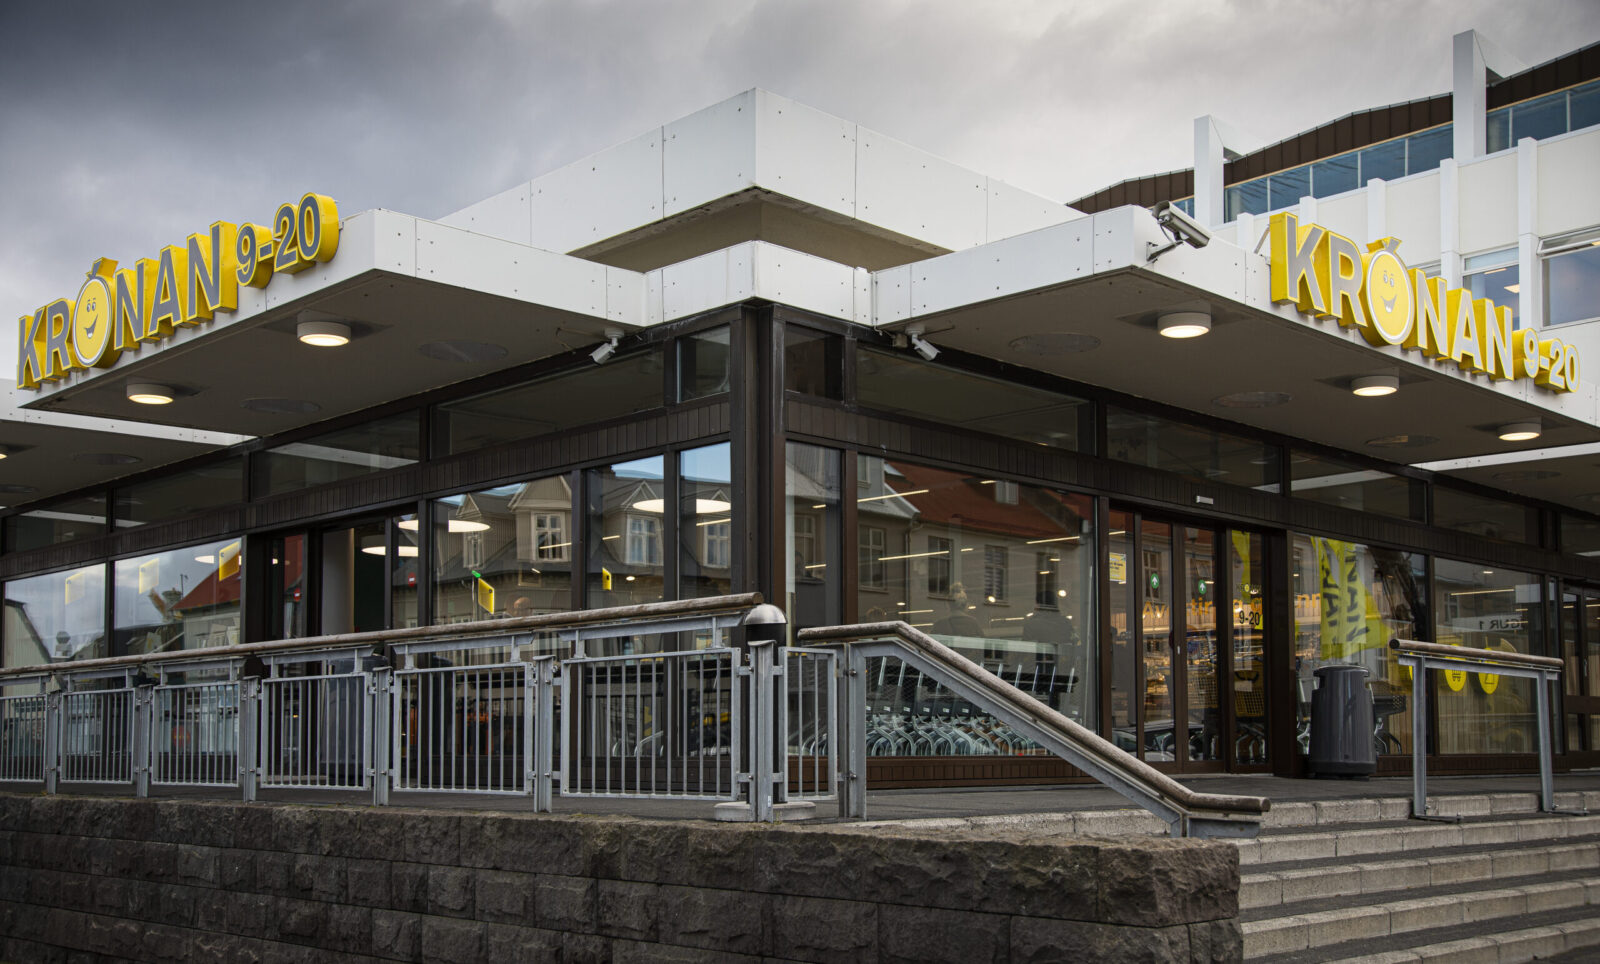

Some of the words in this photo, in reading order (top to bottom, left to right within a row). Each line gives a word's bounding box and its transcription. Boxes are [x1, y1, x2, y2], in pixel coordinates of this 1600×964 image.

[17, 220, 223, 390] KRÓNAN
[235, 192, 323, 287] 9-20
[1285, 212, 1514, 381] KRÓNAN
[1522, 327, 1580, 393] 9-20
[1239, 610, 1260, 626] 9-20
